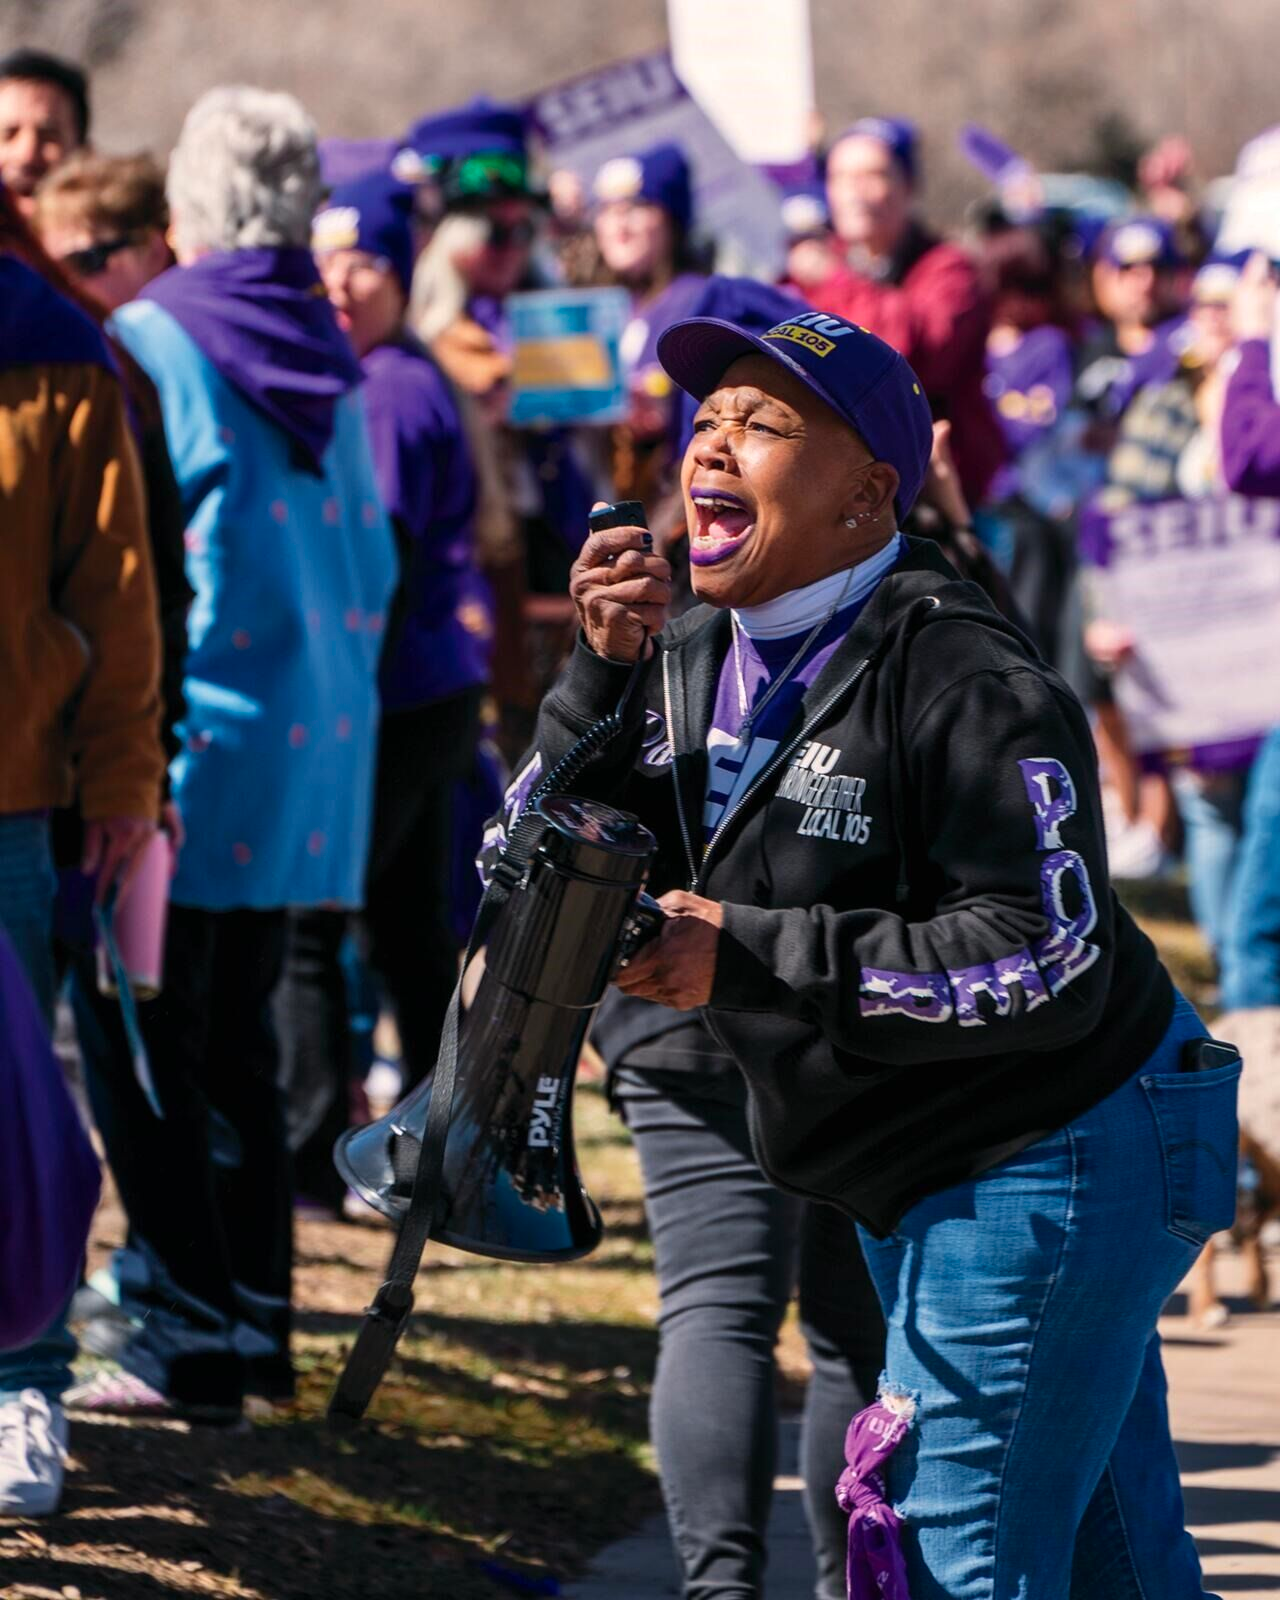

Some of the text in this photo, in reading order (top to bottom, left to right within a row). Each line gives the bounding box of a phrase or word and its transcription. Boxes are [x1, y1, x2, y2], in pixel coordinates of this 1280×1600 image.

[796, 332, 830, 351] 105
[788, 741, 842, 774] EIU
[841, 812, 873, 845] 105
[527, 1077, 560, 1147] PYLE
